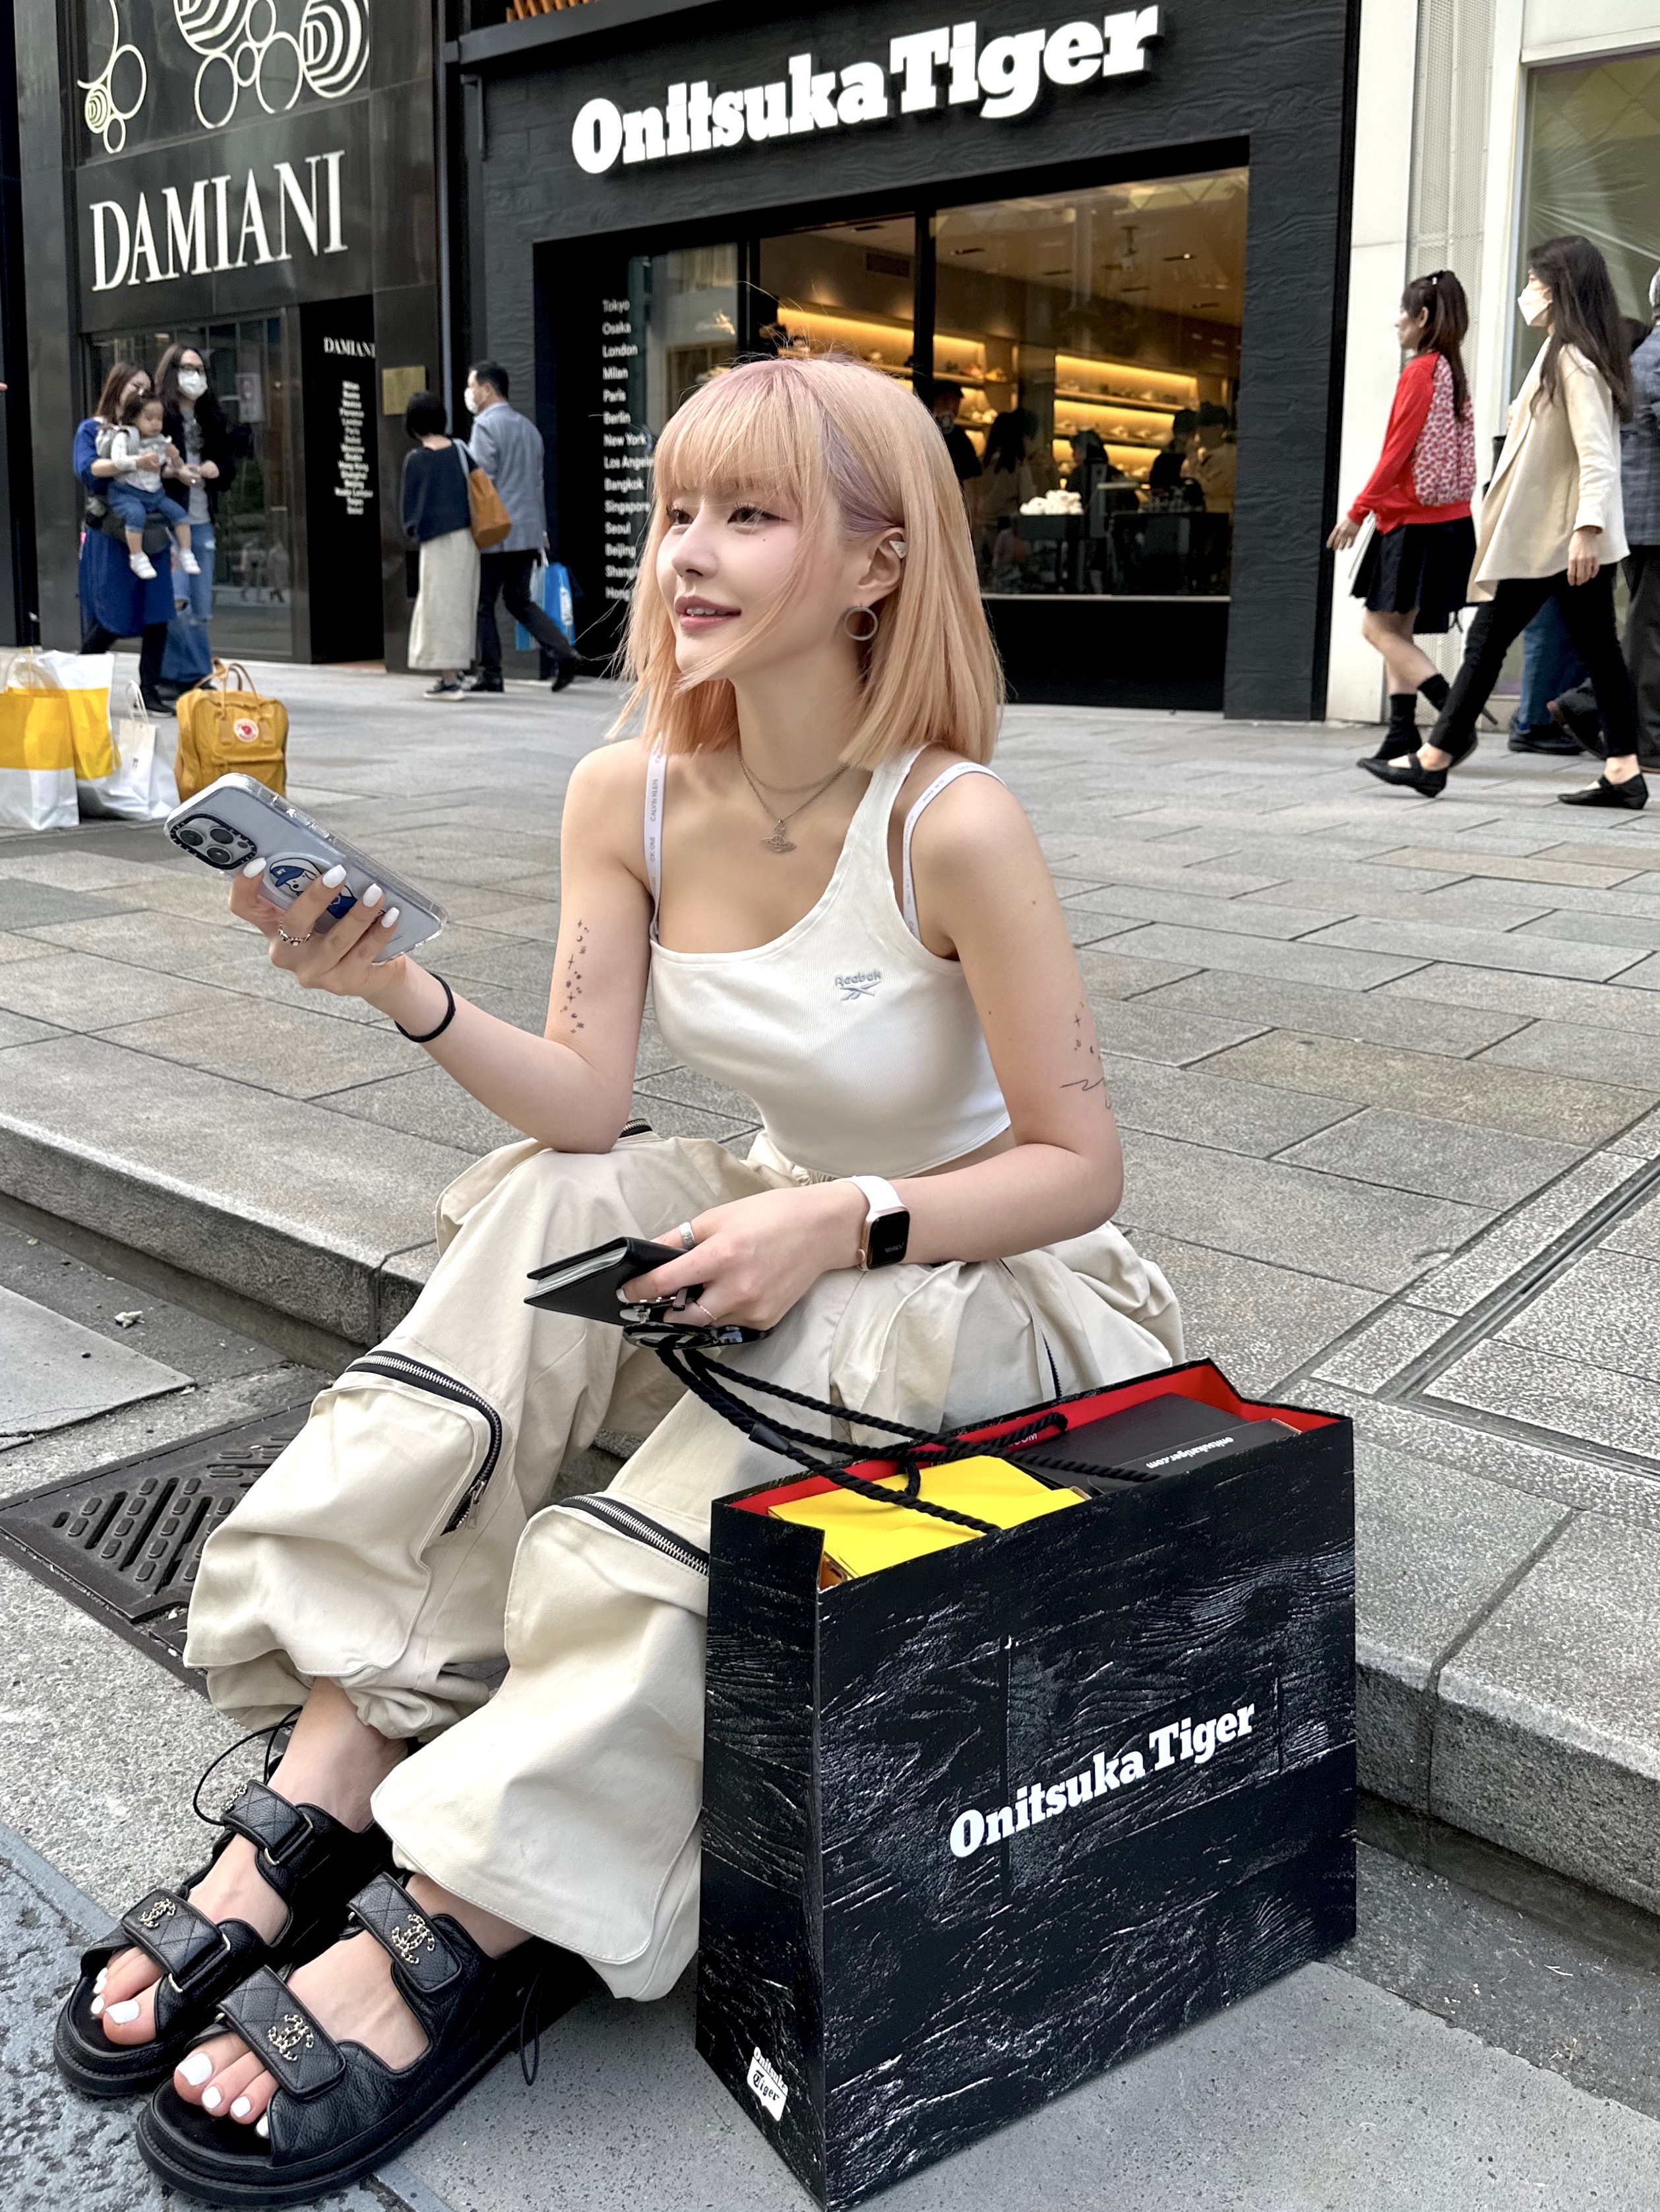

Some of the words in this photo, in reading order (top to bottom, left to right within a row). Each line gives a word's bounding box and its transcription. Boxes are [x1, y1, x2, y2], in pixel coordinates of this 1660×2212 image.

[572, 52, 888, 174] Onitsuka
[890, 5, 1159, 119] Tiger
[89, 150, 348, 292] DAMIANI
[602, 298, 630, 314] Tokyo
[601, 320, 632, 336] Osaka
[602, 342, 638, 358] London
[603, 365, 629, 380] Milan
[603, 387, 627, 403] Paris
[603, 410, 631, 425] Berlin
[603, 433, 625, 447] New
[625, 432, 647, 446] York
[603, 455, 621, 470] Los
[621, 454, 655, 471] Angele
[604, 477, 644, 493] Bangkok
[604, 499, 651, 515] Singapore
[604, 521, 631, 535] Seoul
[605, 543, 636, 559] Beijing
[605, 586, 630, 602] Hong
[834, 970, 881, 987] Reebok
[1146, 1436, 1234, 1469] onitsukatiger.com
[950, 1751, 1146, 1858] Onitsuka
[1149, 1703, 1255, 1771] Tiger
[754, 2046, 789, 2097] Onitsuka
[753, 2070, 780, 2101] Tiger
